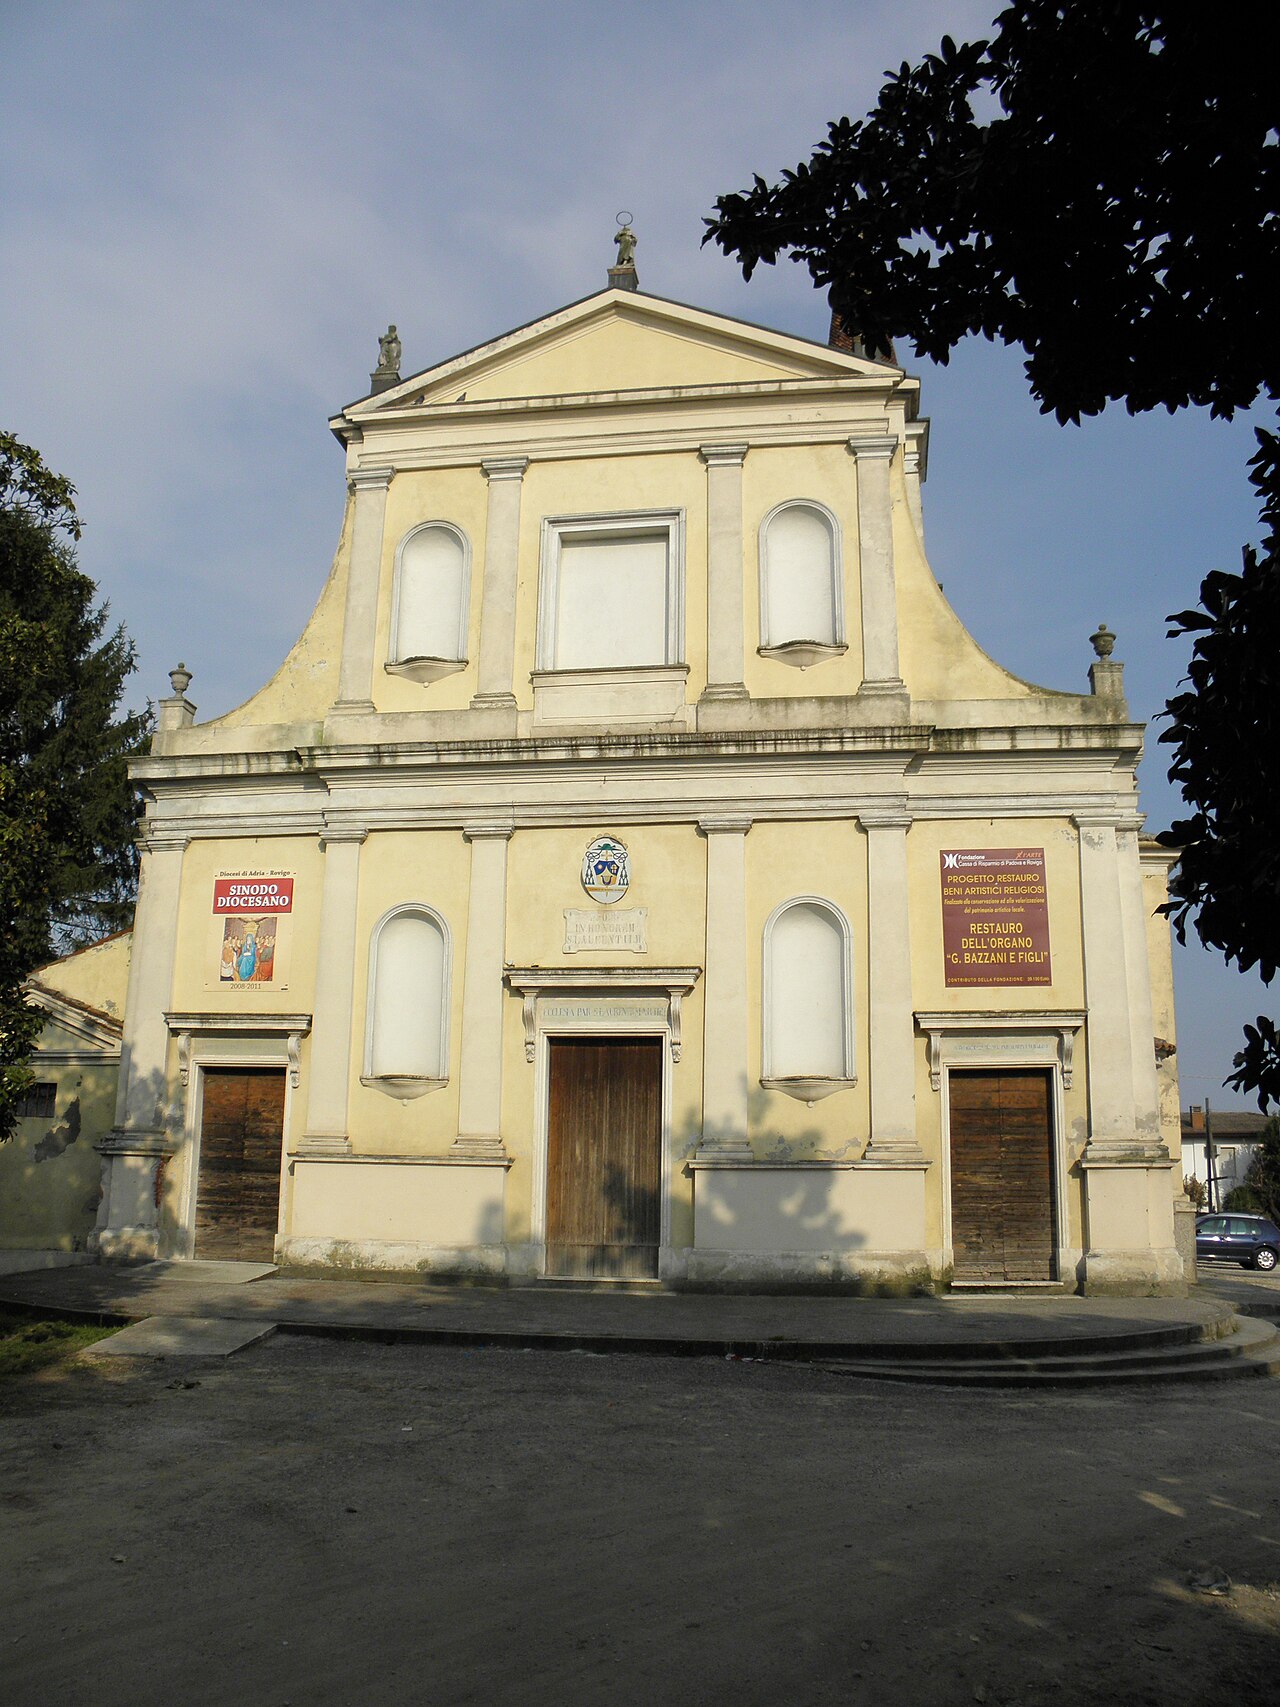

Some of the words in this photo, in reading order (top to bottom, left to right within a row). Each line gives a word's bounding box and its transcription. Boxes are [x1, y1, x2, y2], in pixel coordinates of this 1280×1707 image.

[947, 875, 995, 883] PROGETTO
[997, 873, 1040, 882] RESTAURO
[229, 884, 278, 896] SINODO
[944, 887, 963, 896] BENI
[964, 886, 1002, 895] ARTISTICI
[1004, 885, 1045, 894] RELIGIOSI
[217, 896, 289, 907] DIOCESANO
[970, 923, 1023, 934] RESTAURO
[961, 937, 1033, 949] DELL'ORGANO
[964, 952, 1007, 964] BAZZANI
[1009, 952, 1016, 963] E
